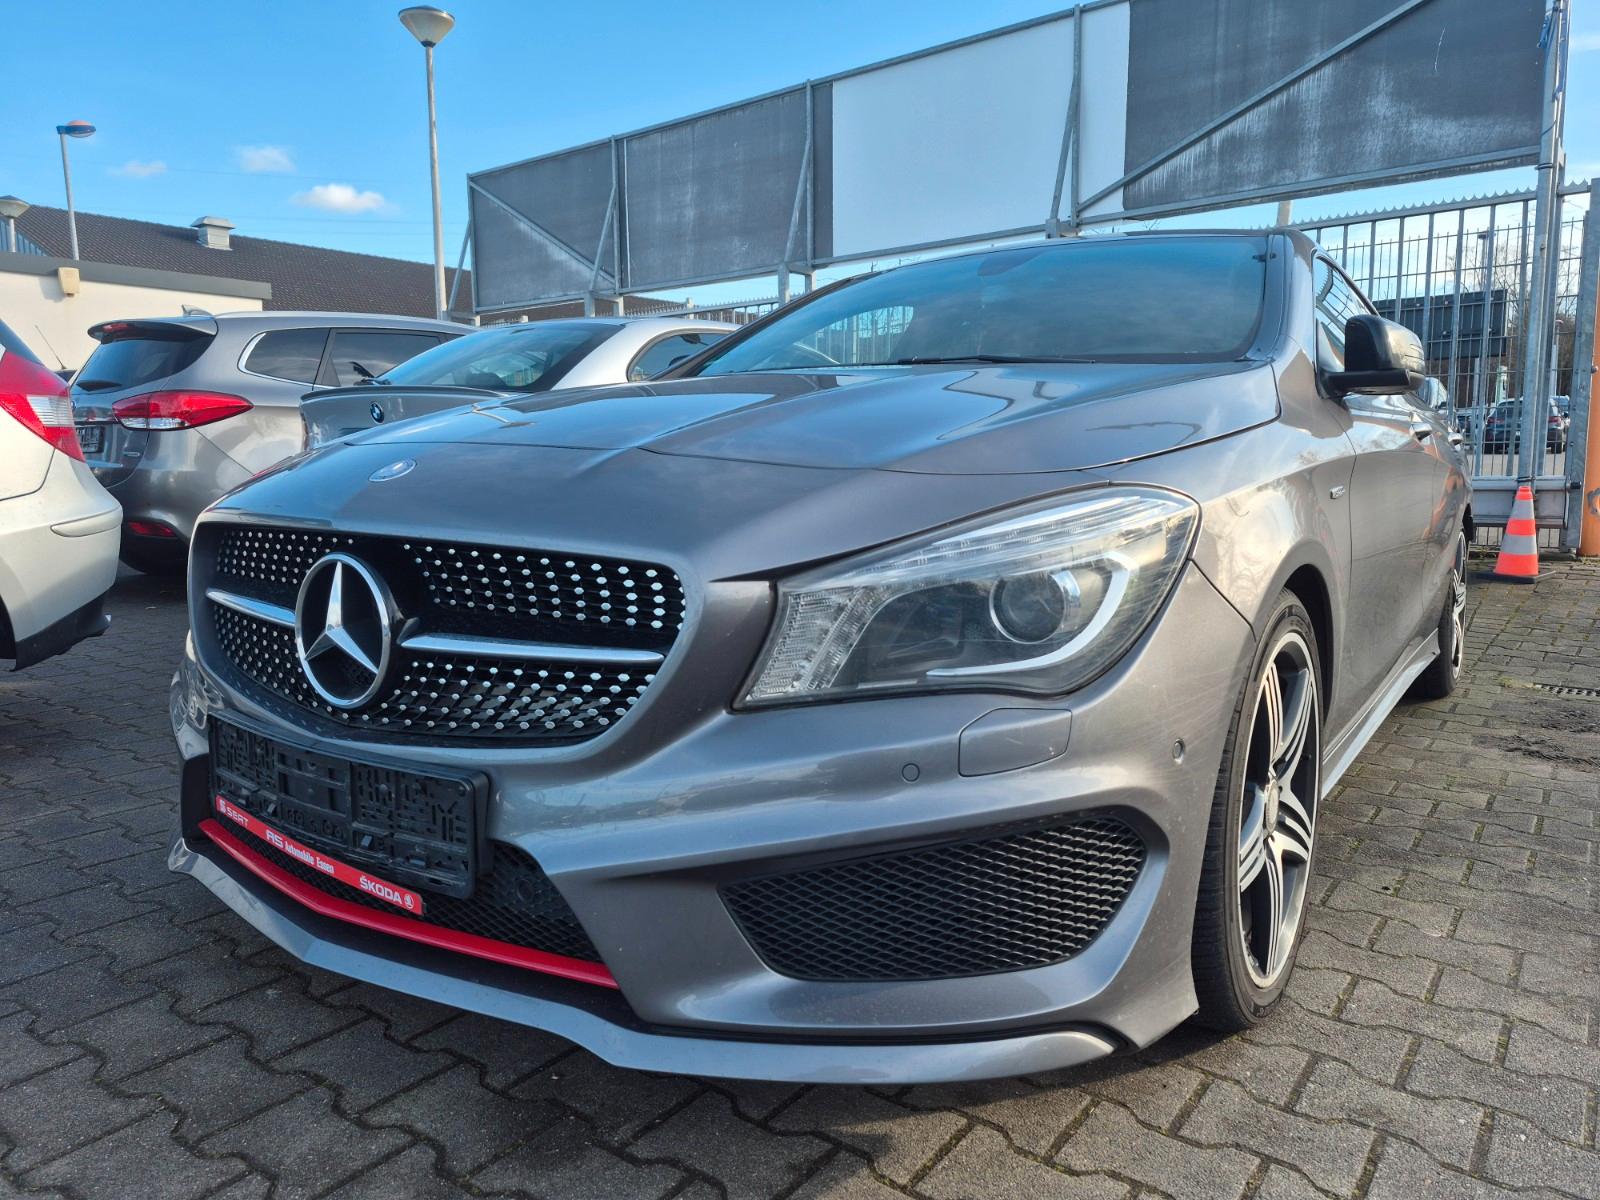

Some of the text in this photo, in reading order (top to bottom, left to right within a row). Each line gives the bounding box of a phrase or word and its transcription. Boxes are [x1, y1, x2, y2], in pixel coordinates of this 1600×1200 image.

[226, 807, 249, 827] SEAT
[285, 841, 315, 865] Automobile
[316, 856, 335, 874] Essen
